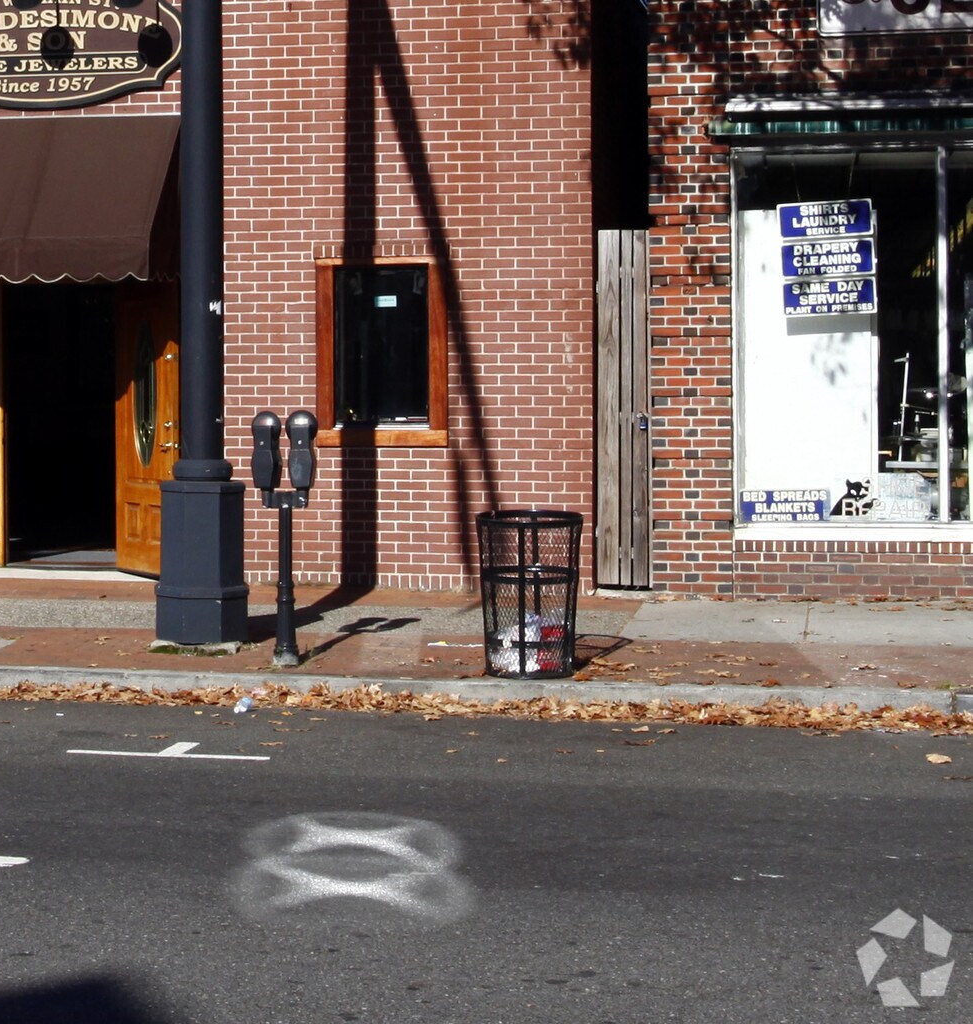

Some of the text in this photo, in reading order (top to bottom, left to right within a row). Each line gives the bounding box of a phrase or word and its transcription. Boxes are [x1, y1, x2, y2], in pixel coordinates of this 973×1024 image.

[27, 30, 87, 51] SON
[13, 56, 139, 73] JEWELERS
[46, 76, 96, 92] 1957
[799, 203, 850, 216] SHIRTS
[791, 214, 857, 228] LAUNDRY
[805, 225, 846, 236] SERVICE
[793, 241, 859, 256] DRAPERY
[792, 253, 862, 267] CLEANING
[797, 264, 858, 275] FAN FOLDED
[791, 280, 865, 294] SAME DAY
[799, 292, 859, 305] SERVICE
[785, 302, 873, 315] PLANT ON PREMISES
[742, 489, 827, 502] BED SPREADS
[754, 501, 816, 514] BLANKETS
[751, 512, 820, 522] SLEEPING BAGS
